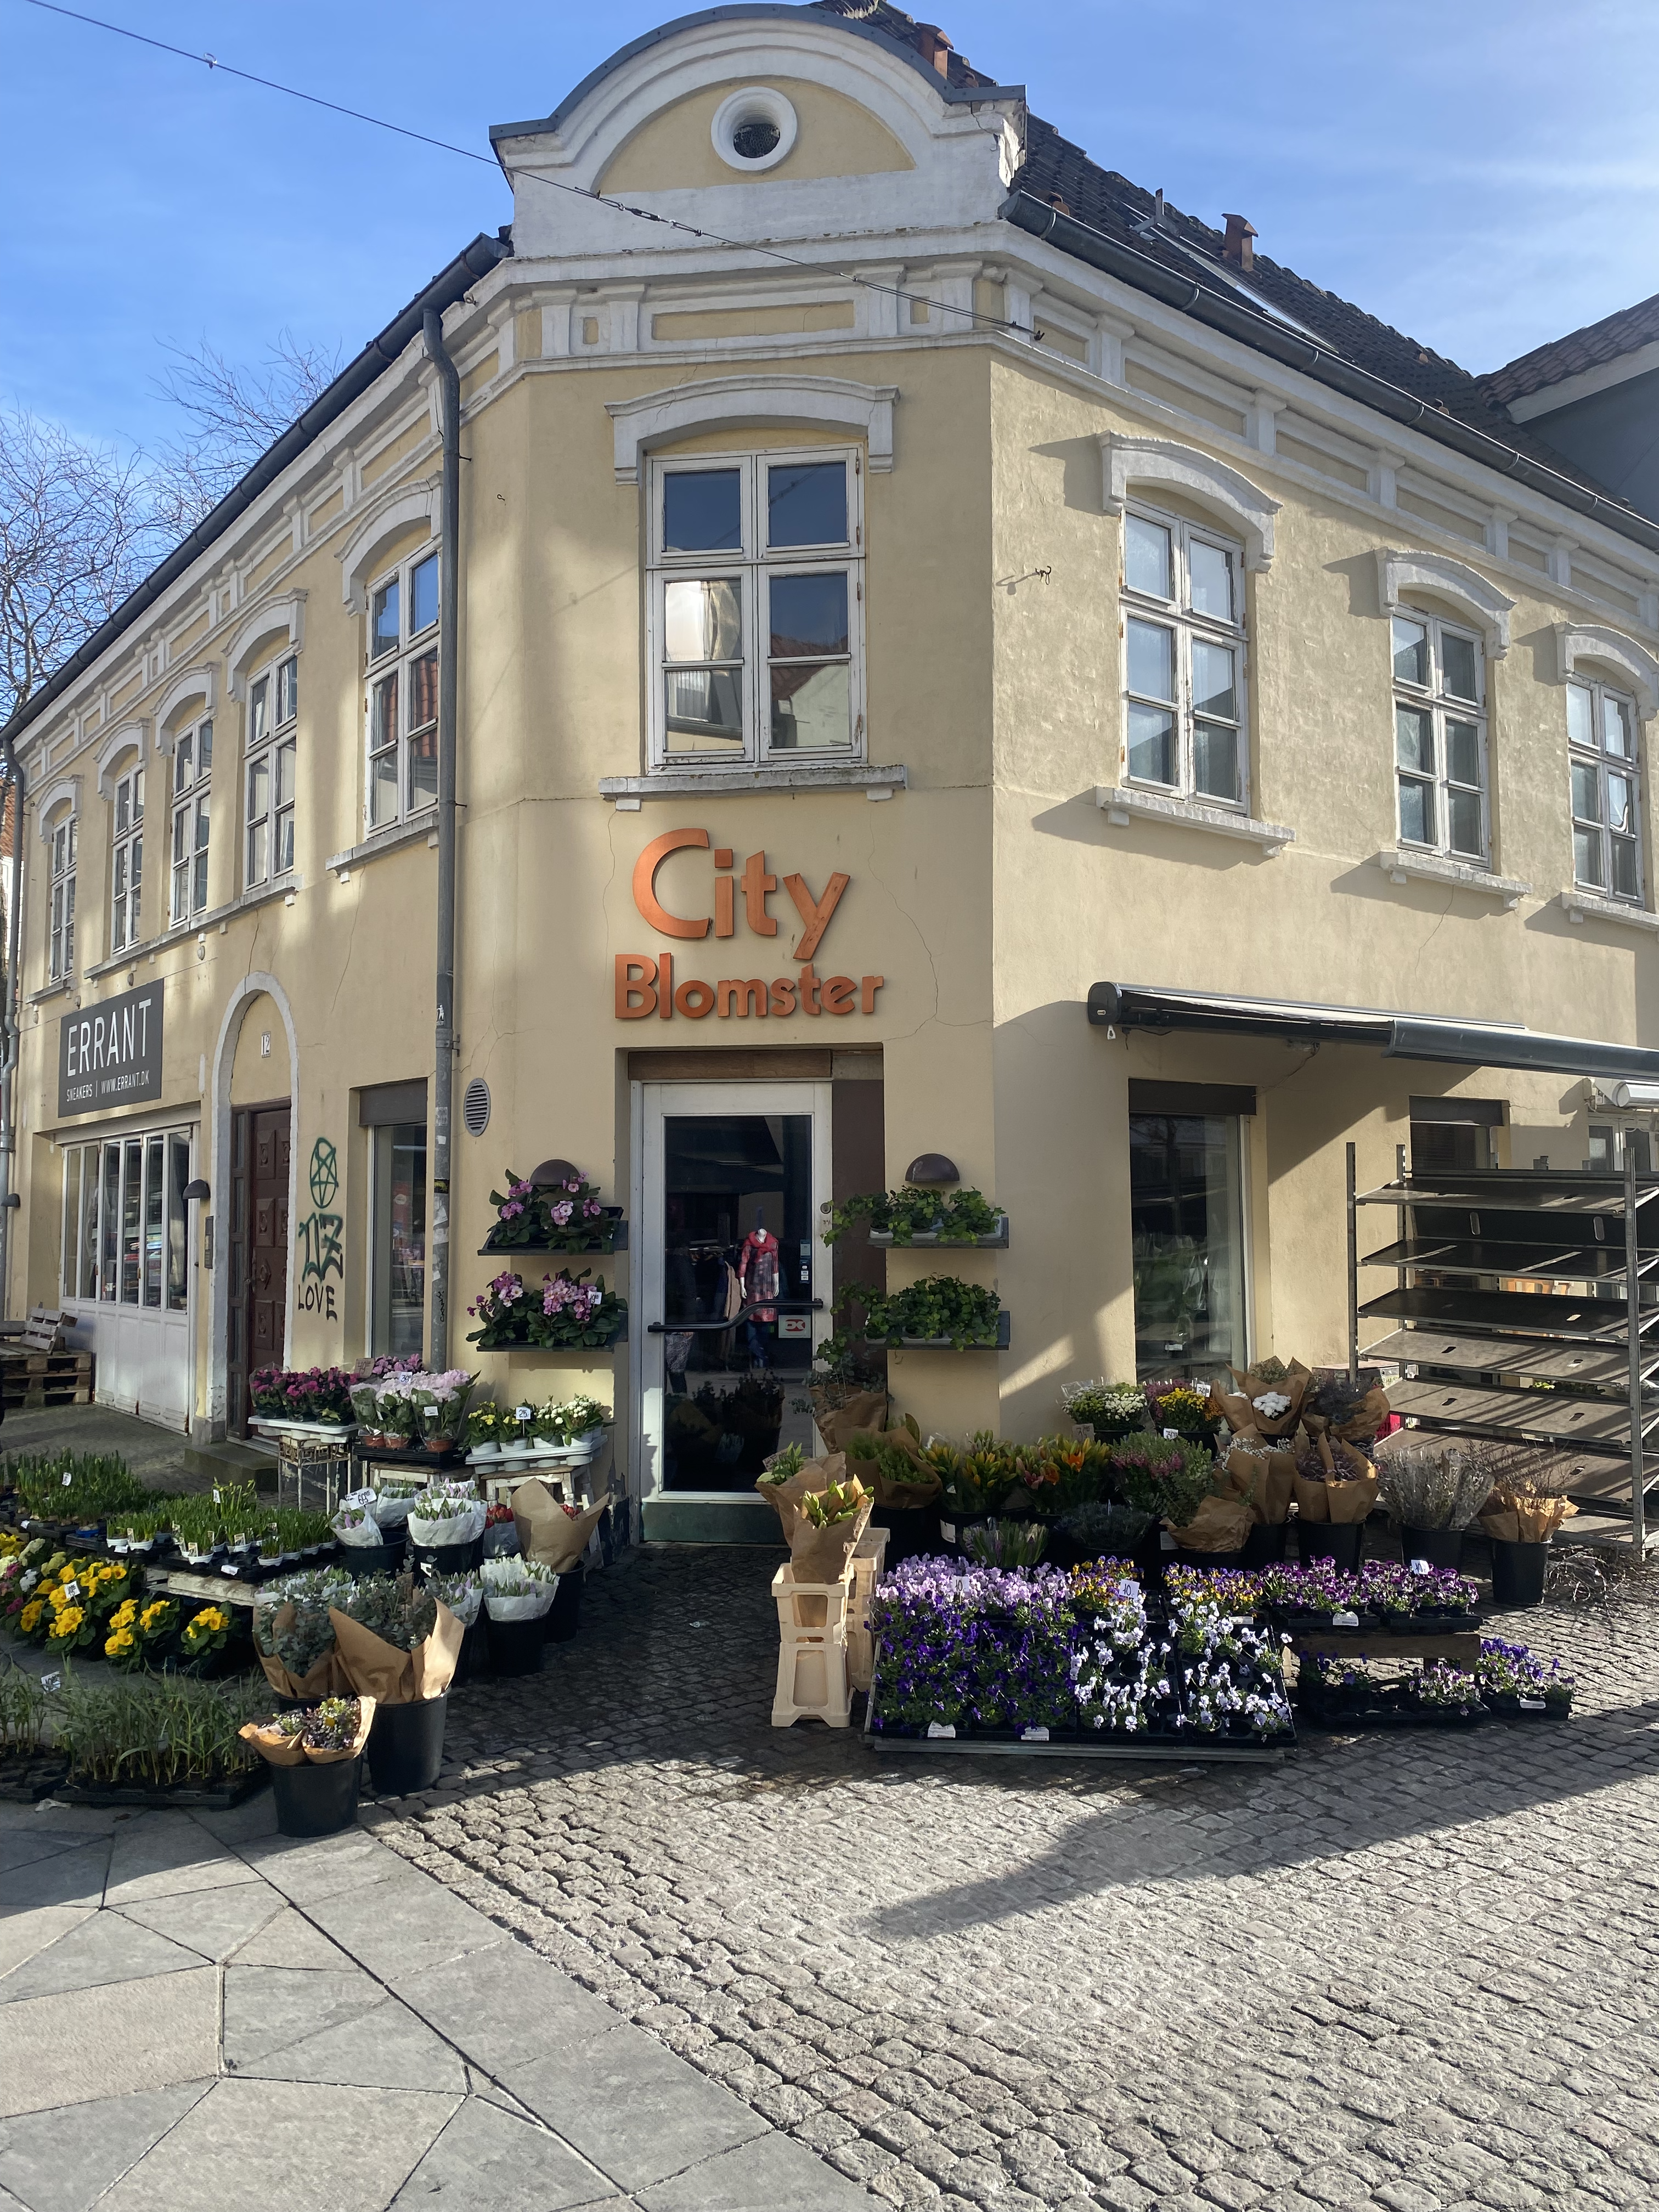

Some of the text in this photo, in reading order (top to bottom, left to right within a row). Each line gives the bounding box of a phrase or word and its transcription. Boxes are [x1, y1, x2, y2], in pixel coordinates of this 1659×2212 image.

[633, 827, 851, 960] City
[614, 952, 884, 1019] Blomster
[67, 998, 151, 1077] ERRANT
[263, 1035, 270, 1054] 12
[66, 1070, 150, 1102] SNEAKERS WWW.ERRANT.DK
[298, 1281, 337, 1323] LOVE
